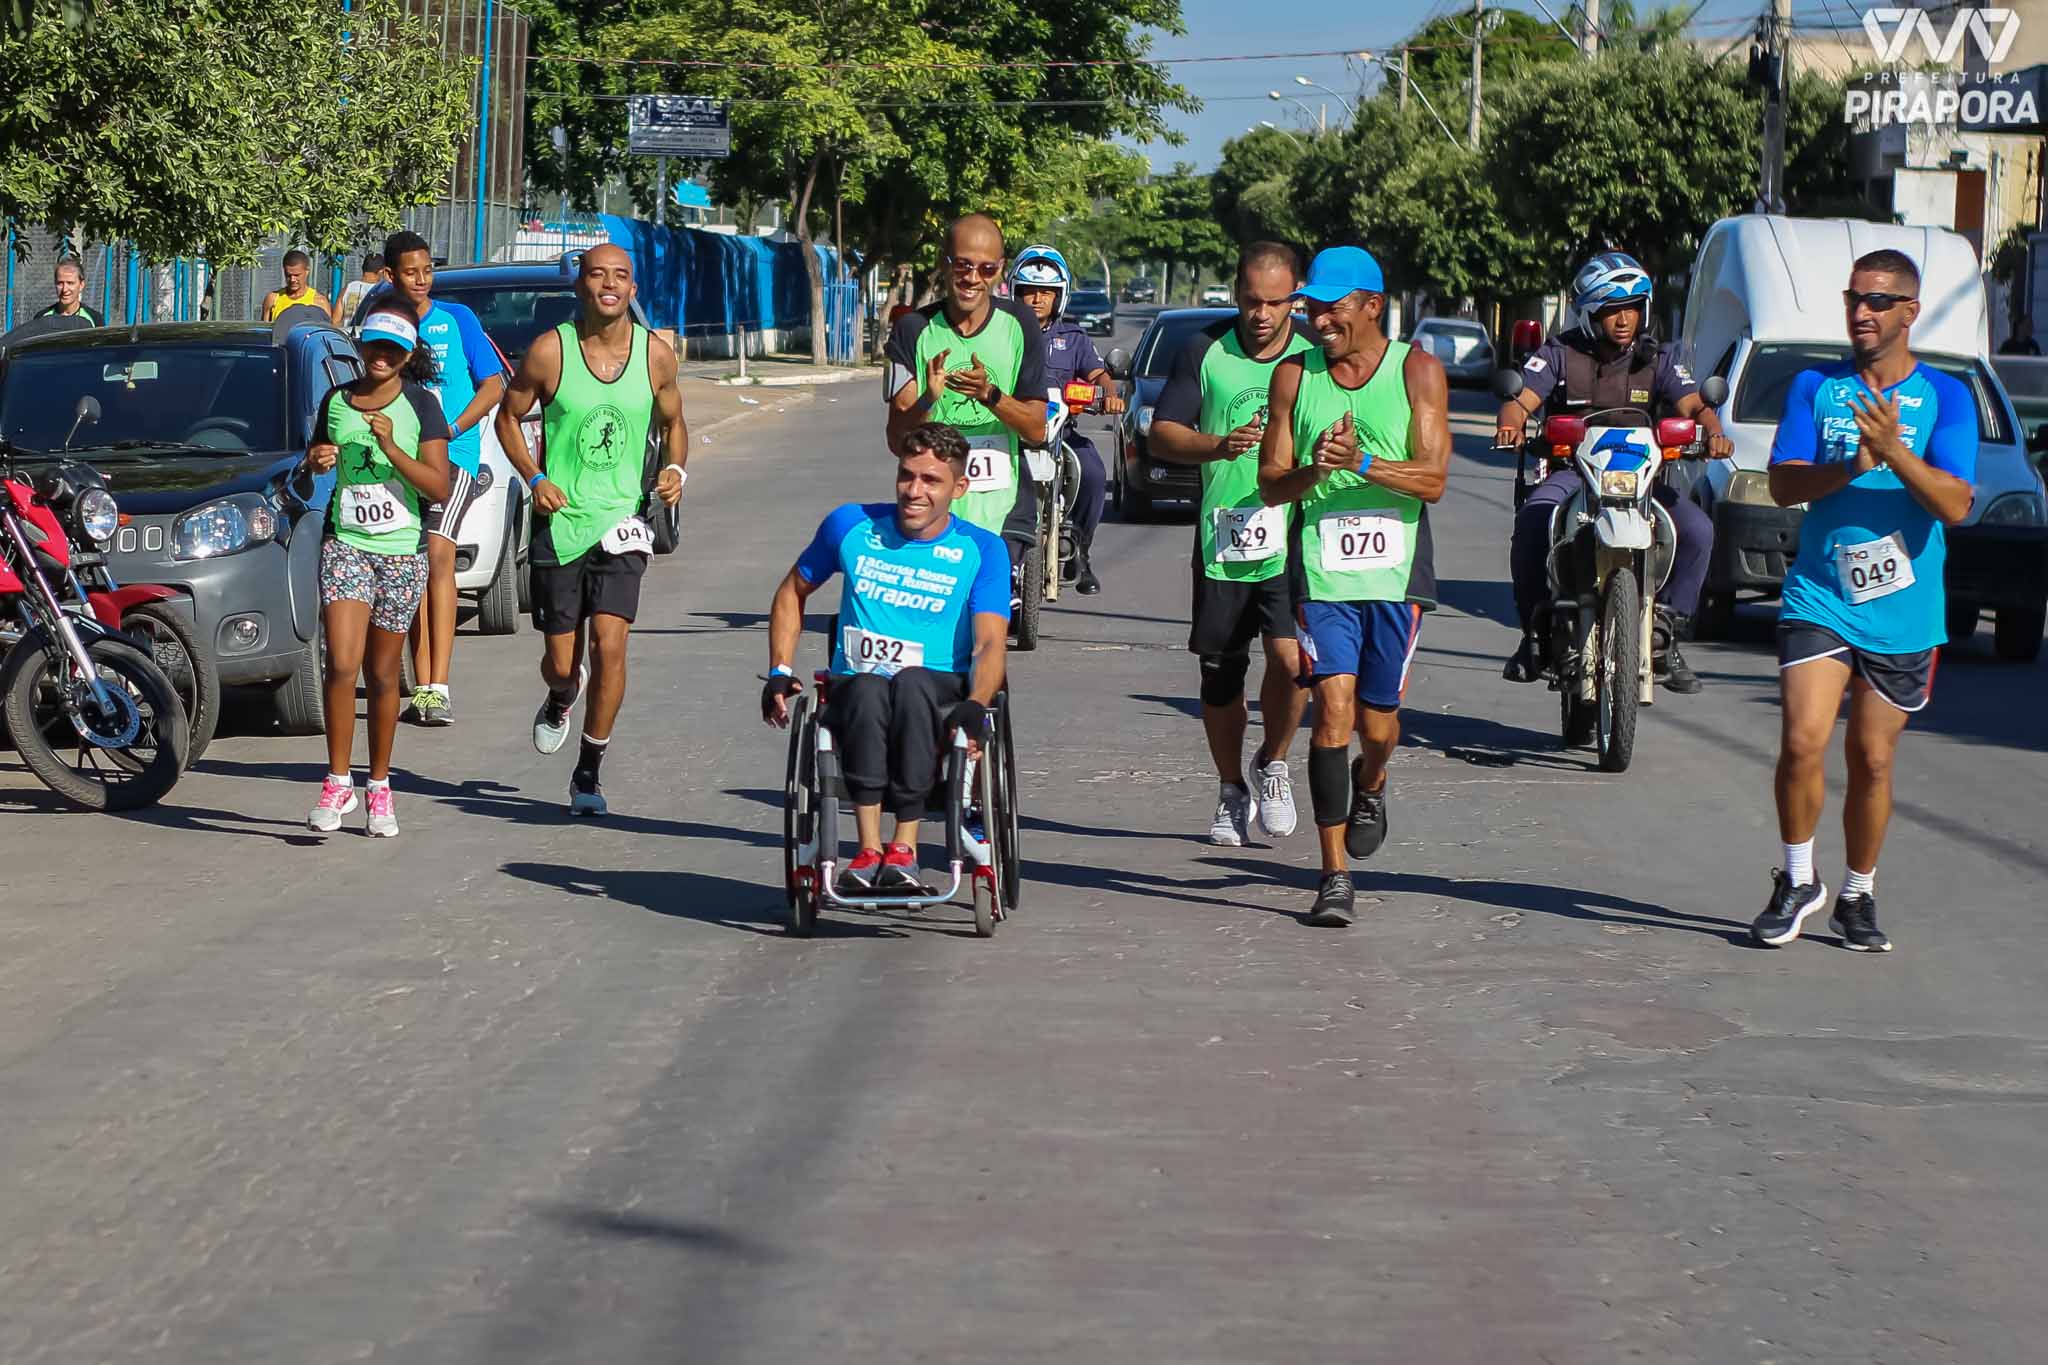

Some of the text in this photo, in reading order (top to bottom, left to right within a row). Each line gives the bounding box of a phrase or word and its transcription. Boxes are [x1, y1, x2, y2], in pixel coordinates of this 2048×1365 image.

[1234, 392, 1255, 411] STREET
[967, 456, 993, 478] 61
[355, 501, 394, 524] 008
[1231, 526, 1267, 548] 029
[1340, 531, 1386, 556] 070
[1851, 558, 1897, 589] 049
[854, 577, 946, 613] Pirapora
[860, 636, 904, 663] 032
